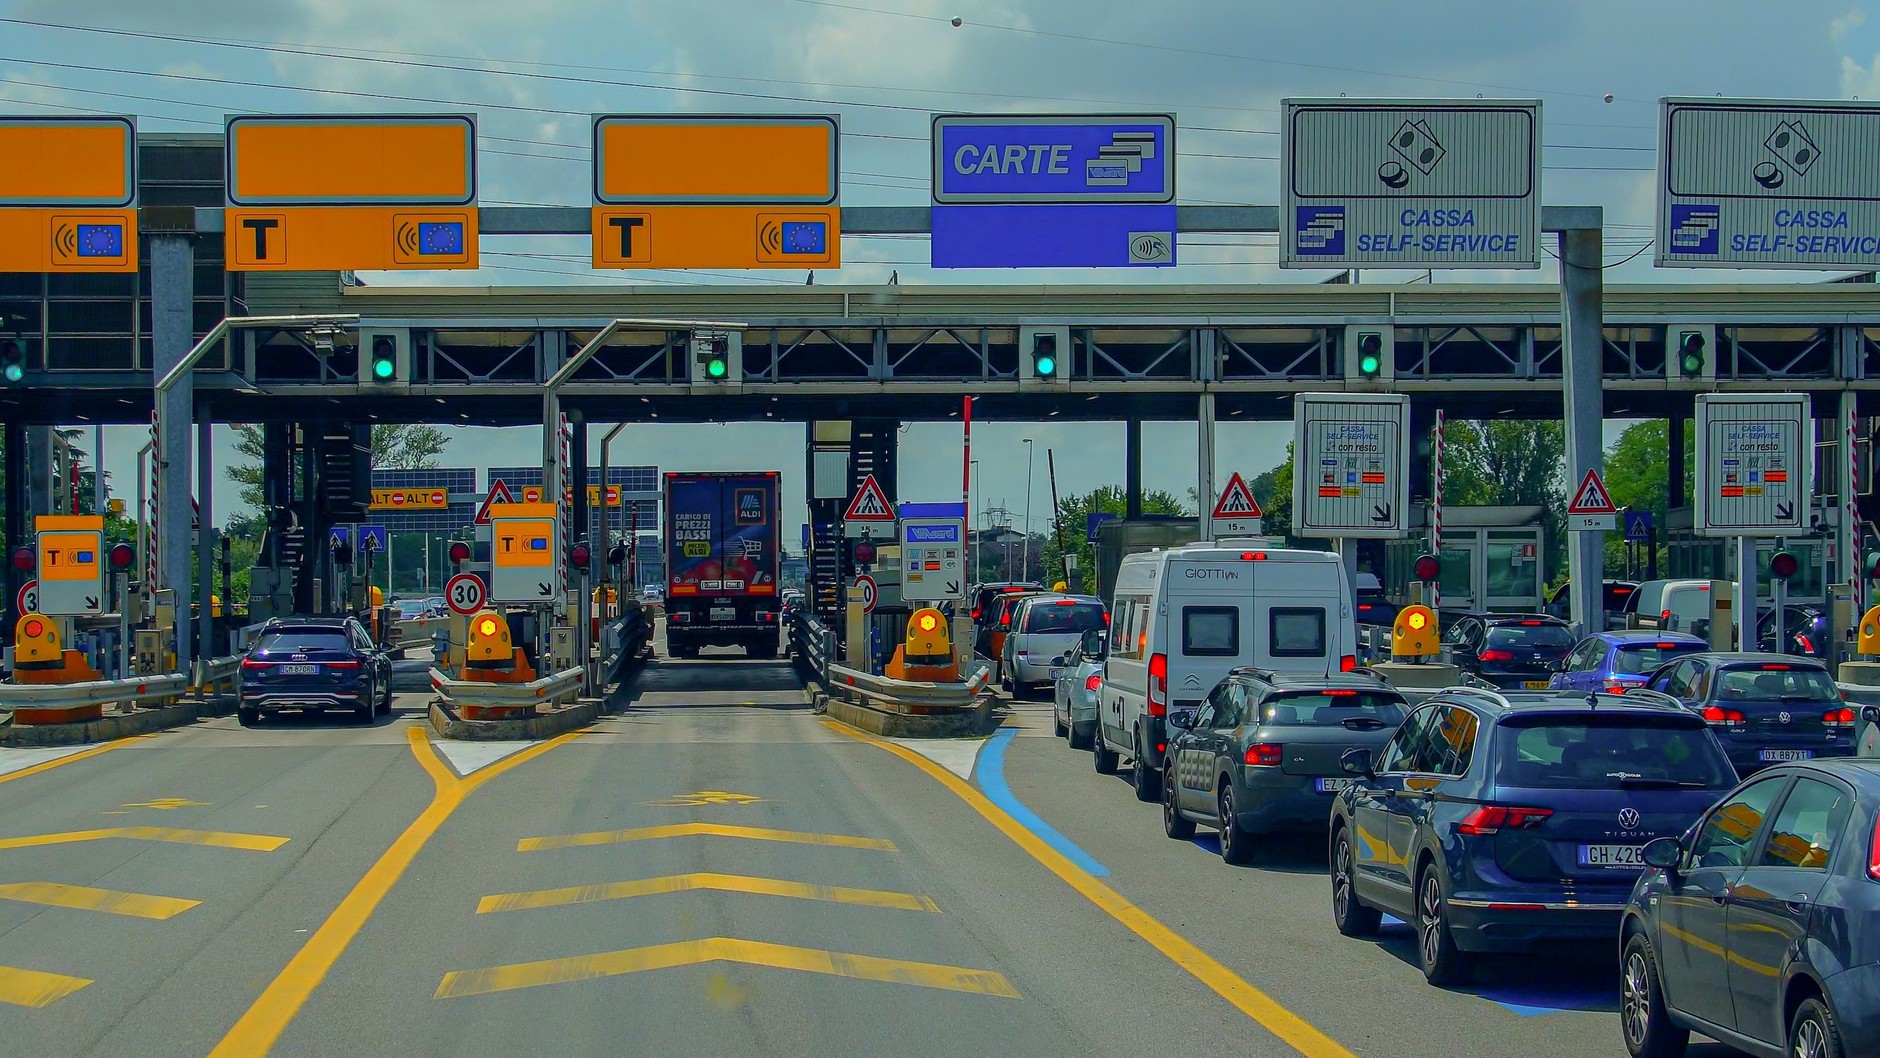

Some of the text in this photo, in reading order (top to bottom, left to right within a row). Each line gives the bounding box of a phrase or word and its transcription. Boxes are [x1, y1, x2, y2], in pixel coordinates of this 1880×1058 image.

[954, 144, 1072, 175] CARTE
[1400, 209, 1475, 228] CASSA
[1774, 209, 1848, 229] CASSA
[243, 219, 279, 260] T
[609, 217, 643, 258] T
[1357, 234, 1519, 253] SELF-SERVICE
[1340, 425, 1365, 433] CASSA
[1741, 425, 1766, 433] CASSA
[1338, 442, 1377, 452] con resto
[1740, 441, 1779, 451] con resto
[370, 493, 429, 504] ALT ALT
[740, 510, 761, 518] ALDI
[675, 520, 711, 530] PREZZI
[1228, 523, 1238, 531] 15
[1583, 519, 1594, 527] 15
[675, 529, 711, 540] BASSI
[502, 537, 514, 552] T
[47, 550, 60, 566] T
[454, 585, 478, 604] 30
[864, 585, 872, 603] 0
[26, 592, 38, 612] 3
[1765, 751, 1807, 760] DX 887XT
[1323, 779, 1338, 791] EZ
[1589, 846, 1644, 864] GH 426
